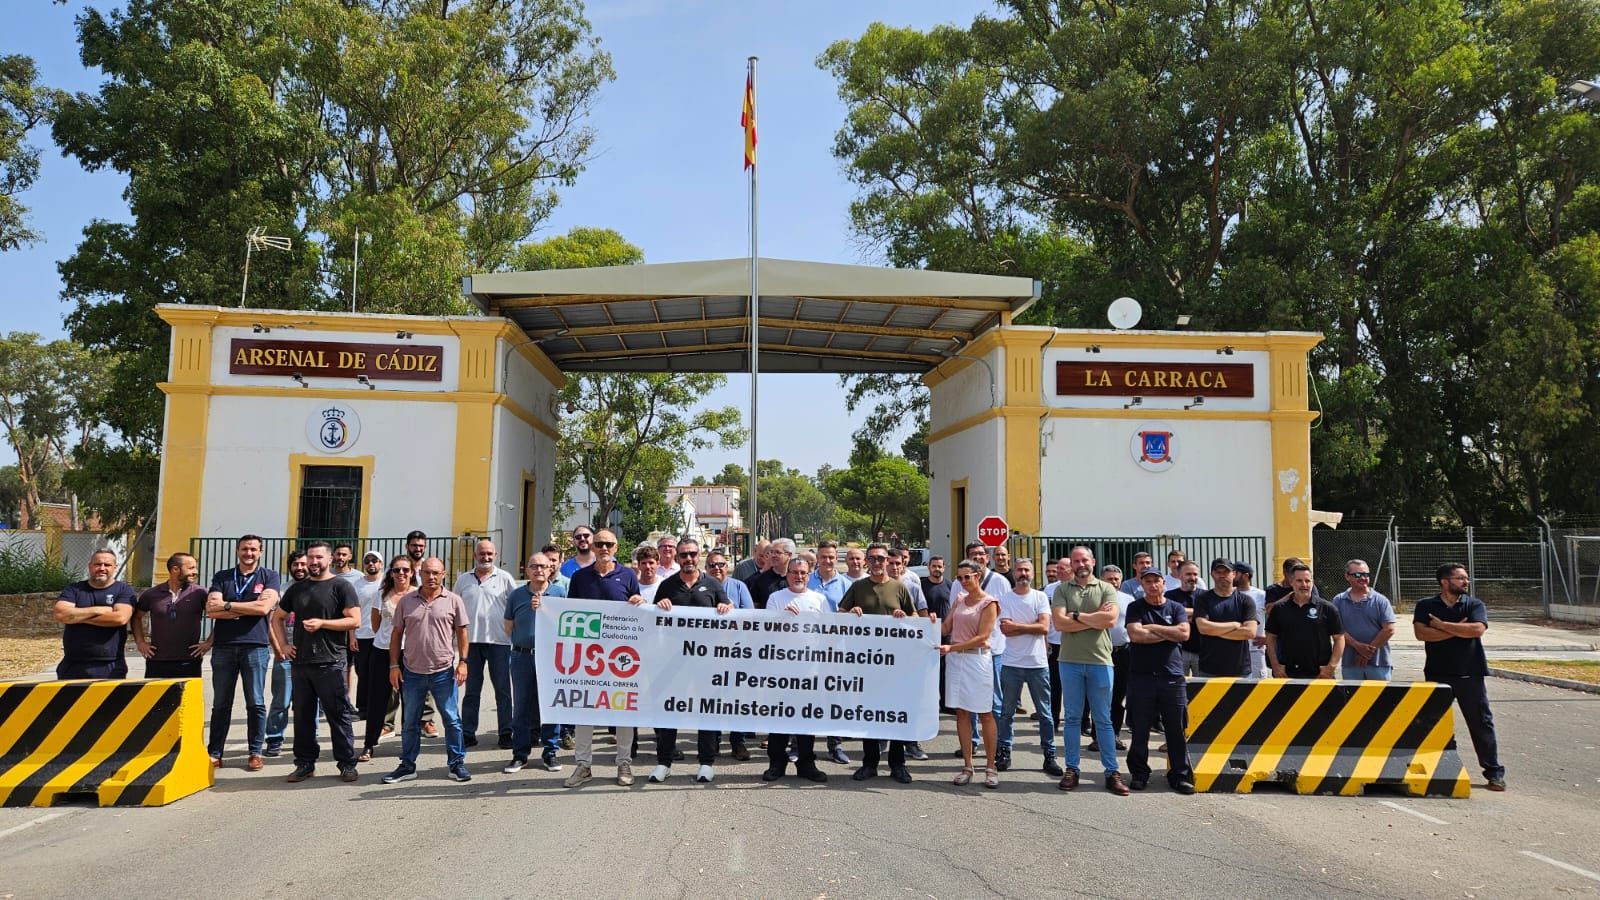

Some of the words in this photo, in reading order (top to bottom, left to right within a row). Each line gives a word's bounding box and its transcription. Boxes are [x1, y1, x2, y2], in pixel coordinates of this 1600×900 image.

[234, 348, 330, 369] ARSENAL
[337, 351, 366, 369] DE
[375, 349, 437, 372] CÁDIZ
[1085, 370, 1113, 387] LA
[1124, 370, 1228, 388] CARRACA
[980, 528, 1007, 536] STOP
[602, 623, 631, 632] Atención
[637, 624, 645, 632] la
[603, 614, 639, 622] Federación
[655, 616, 673, 627] EN
[677, 618, 738, 631] DEFENSA
[742, 621, 760, 632] DE
[764, 622, 799, 633] UNOS
[802, 623, 871, 637] SALARIOS
[874, 627, 924, 640] DIGNOS
[555, 642, 641, 678] USO
[683, 640, 708, 657] No
[713, 642, 752, 659] más
[758, 644, 895, 666] discriminación
[554, 678, 579, 686] UNIÓN
[580, 679, 611, 688] SINDICAL
[711, 671, 729, 687] al
[735, 671, 818, 691] Personal
[824, 675, 864, 693] Civil
[551, 688, 639, 710] APLAGE
[663, 696, 694, 713] del
[699, 698, 796, 719] Ministerio
[801, 703, 825, 719] de
[830, 703, 909, 724] Defensa
